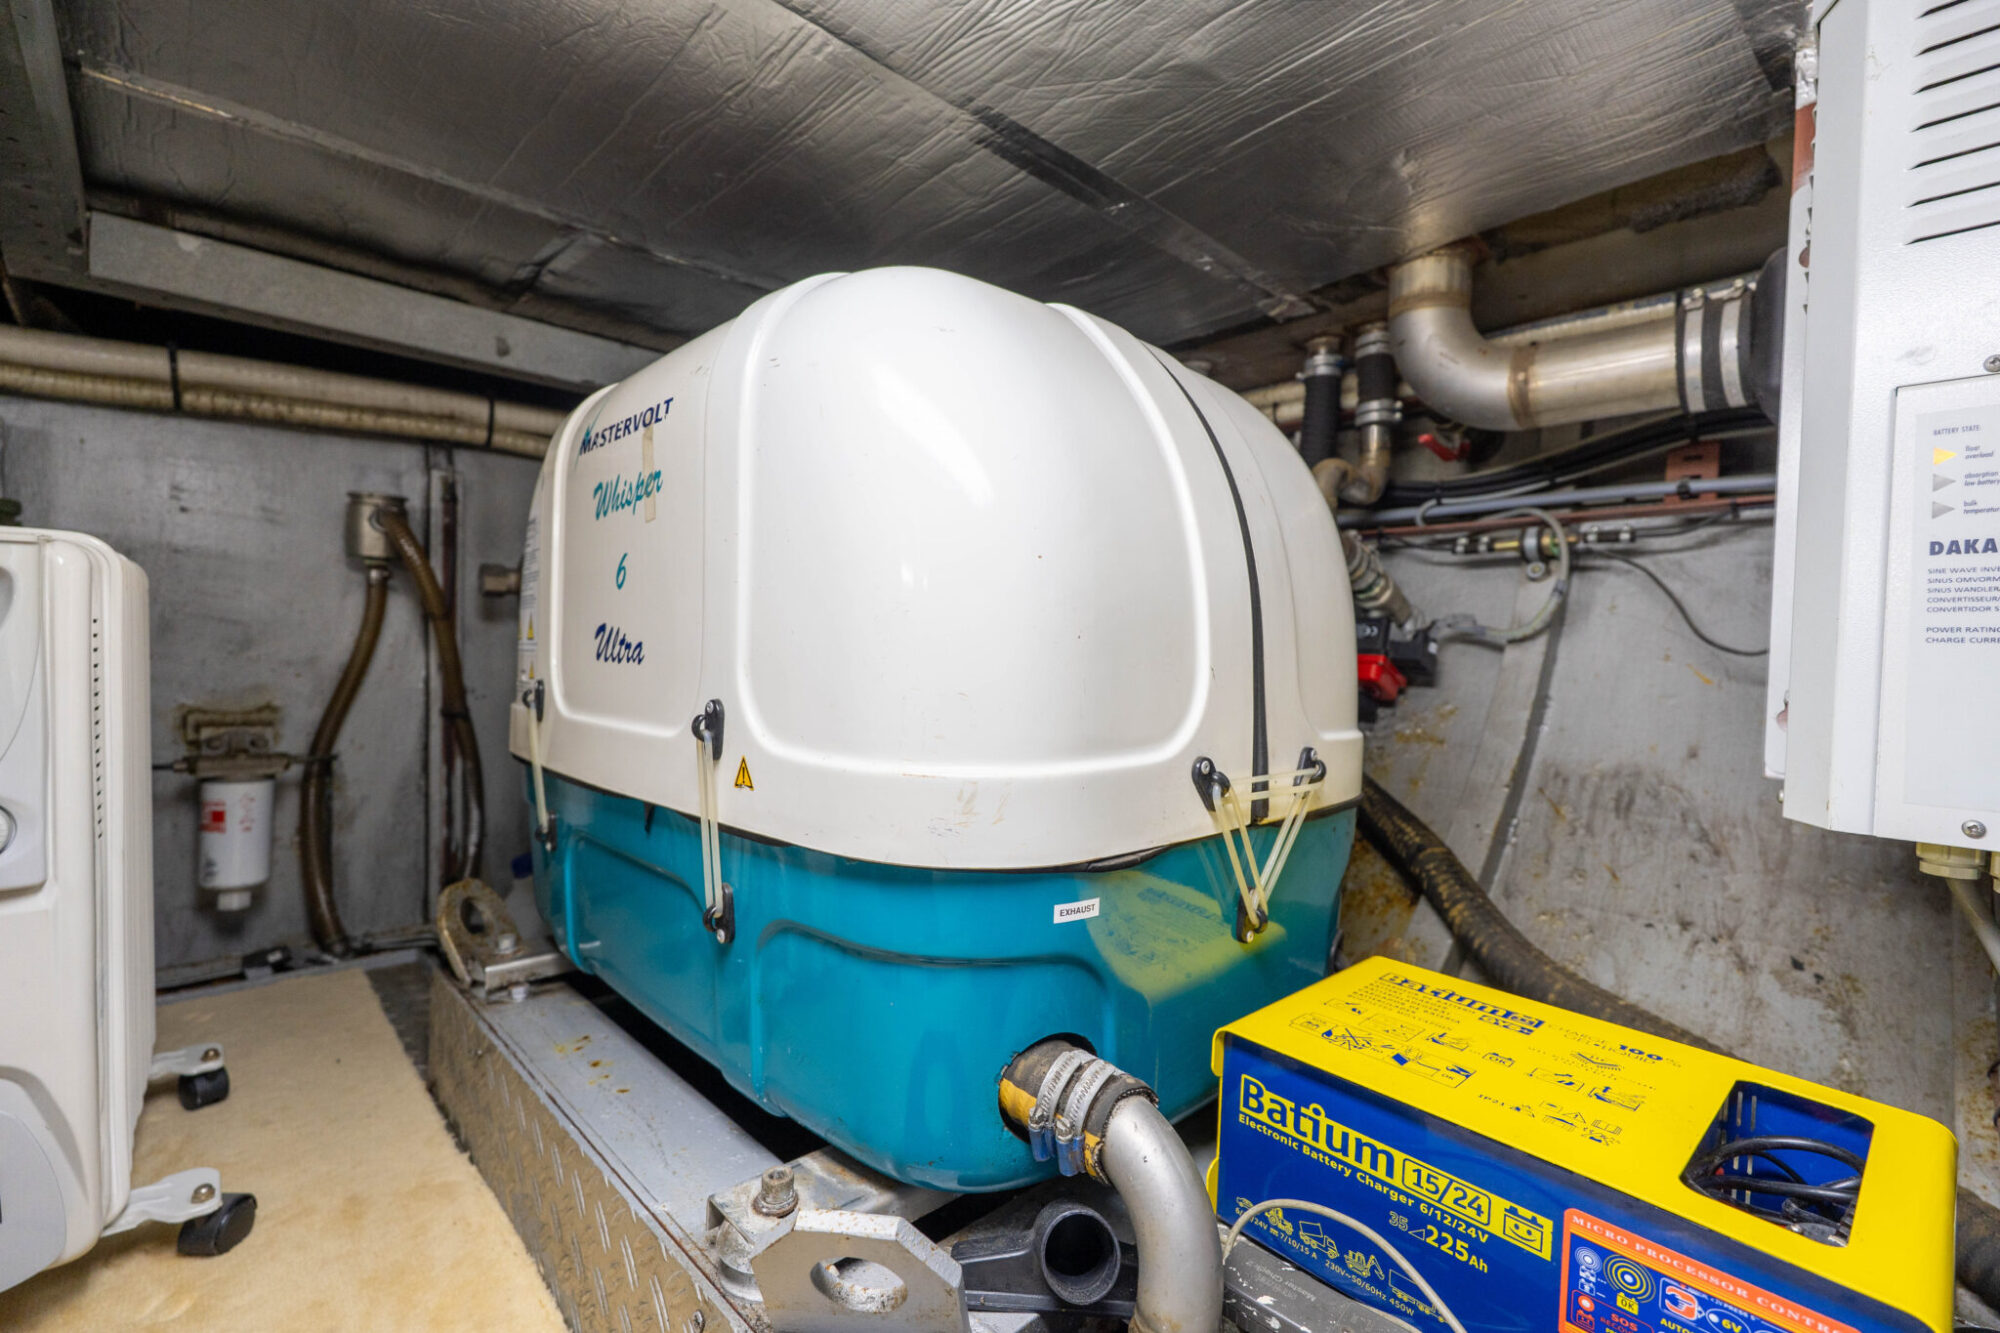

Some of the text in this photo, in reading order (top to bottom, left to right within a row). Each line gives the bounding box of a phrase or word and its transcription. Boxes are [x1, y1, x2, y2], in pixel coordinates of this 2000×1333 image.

[579, 397, 674, 456] MASTERVOLT
[593, 470, 663, 521] Whisper
[1929, 538, 1998, 555] DAKA
[616, 553, 628, 590] 6
[595, 623, 645, 665] Ultra
[1059, 903, 1096, 917] EXHAUST
[1243, 1077, 1485, 1218] Batium 15/24
[1239, 1113, 1489, 1243] Electronic Battery Charger 6/12/24V
[1389, 1211, 1408, 1231] 35
[1573, 1215, 1628, 1245] MICRO
[1635, 1242, 1749, 1298] PROCESSOR
[1611, 1313, 1638, 1332] SOS
[1620, 1299, 1635, 1311] OK
[1721, 1319, 1742, 1333] 6V
